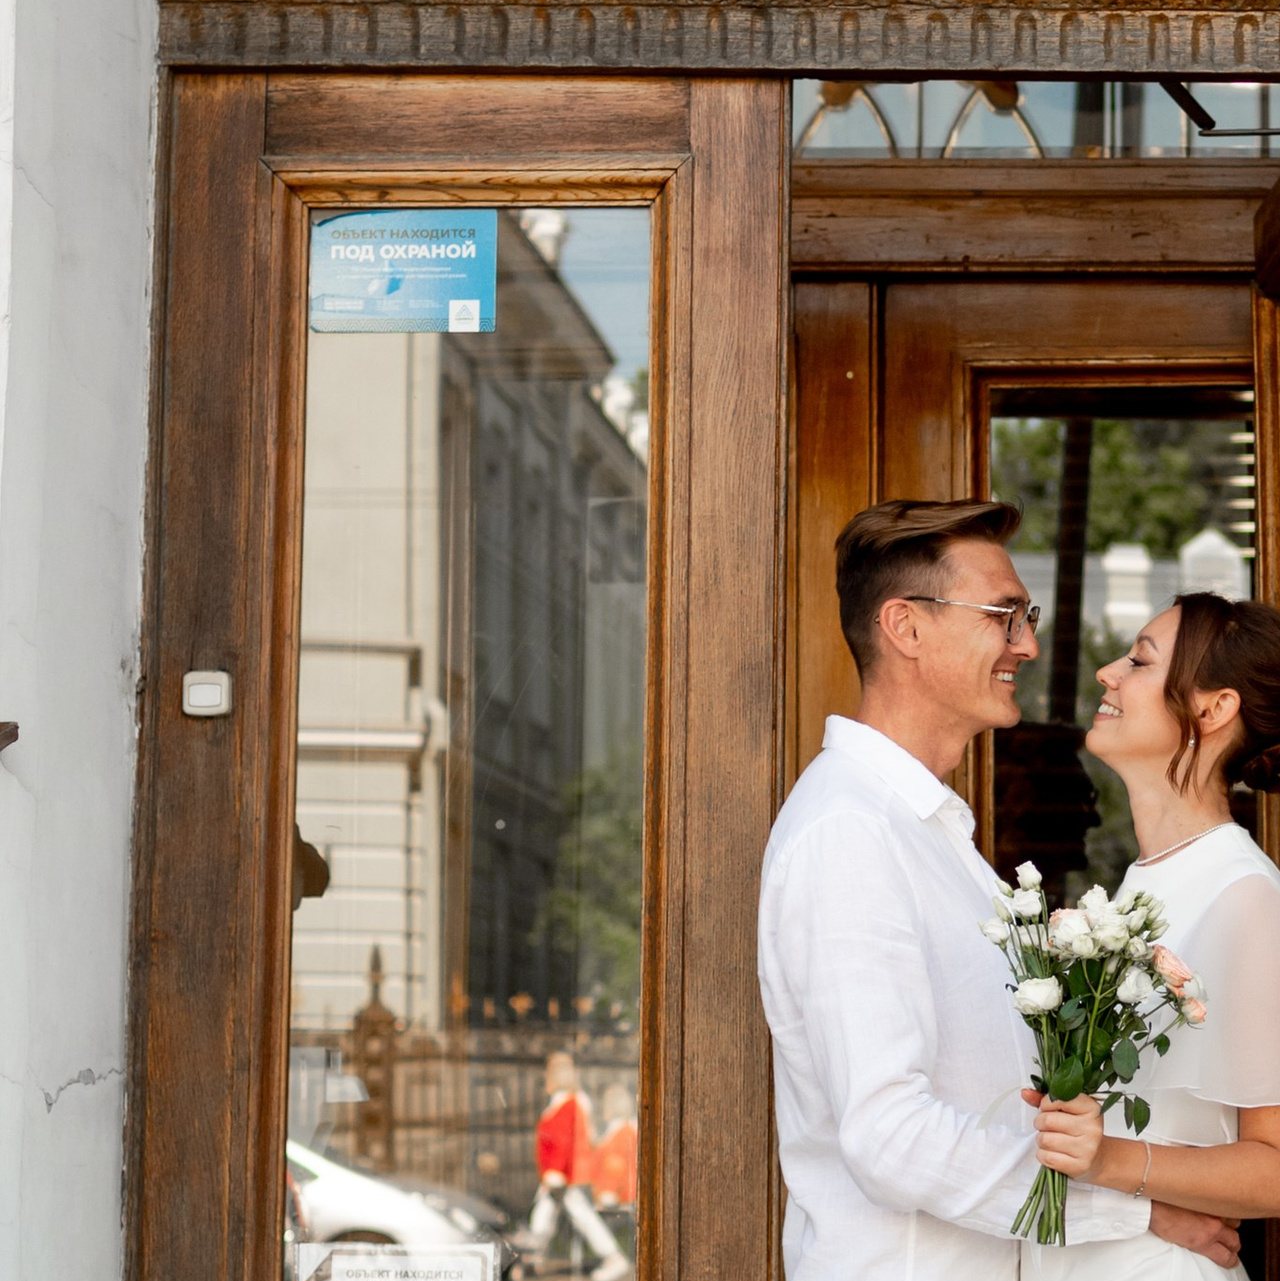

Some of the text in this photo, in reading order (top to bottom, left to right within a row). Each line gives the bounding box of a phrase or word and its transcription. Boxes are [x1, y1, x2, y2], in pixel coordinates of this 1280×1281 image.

[330, 228, 476, 241] ОБЪЕКТ НАХОДИТСЯ
[330, 240, 477, 262] ПОД ОХРАНОЙ
[345, 1269, 464, 1280] ОБЪЕКТ НАХОДИТСЯ
